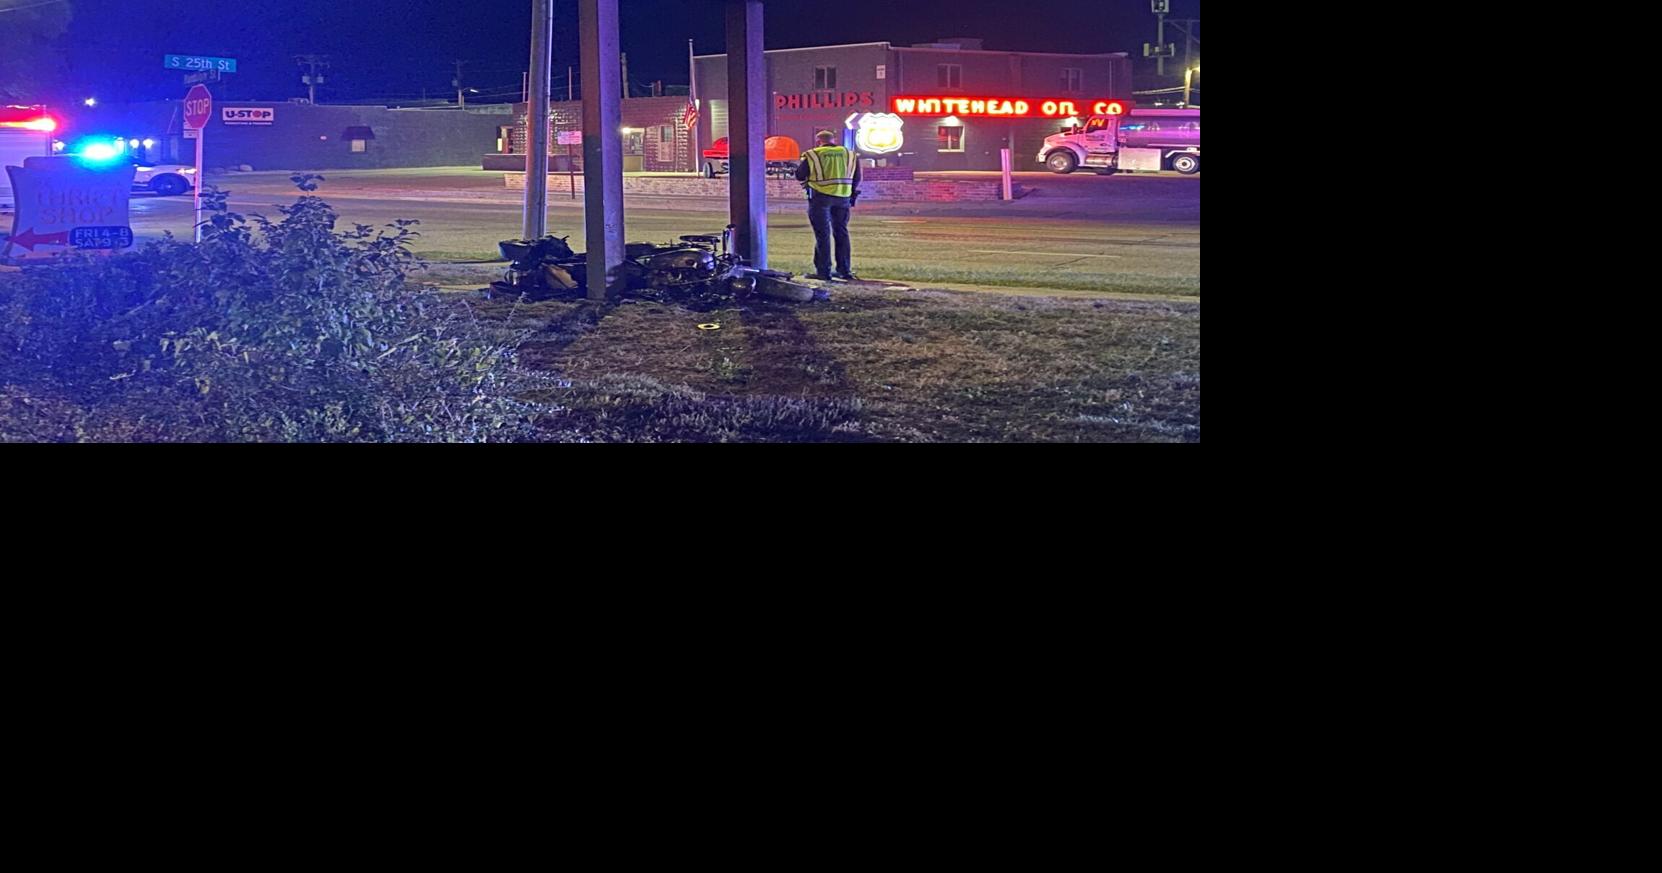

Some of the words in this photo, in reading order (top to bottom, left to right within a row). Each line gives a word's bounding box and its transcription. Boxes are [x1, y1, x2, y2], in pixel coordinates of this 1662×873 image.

[171, 56, 180, 67] S
[186, 57, 212, 69] 25th
[217, 60, 230, 71] St
[186, 98, 210, 117] STOP
[775, 92, 874, 109] PHILLIPS
[895, 98, 1029, 114] WHITEHEAD
[1093, 102, 1123, 115] CO
[225, 110, 271, 118] U-STOP
[41, 207, 113, 225] SHOP
[75, 229, 98, 238] FRI
[75, 238, 100, 248] SAT
[103, 237, 129, 247] 93
